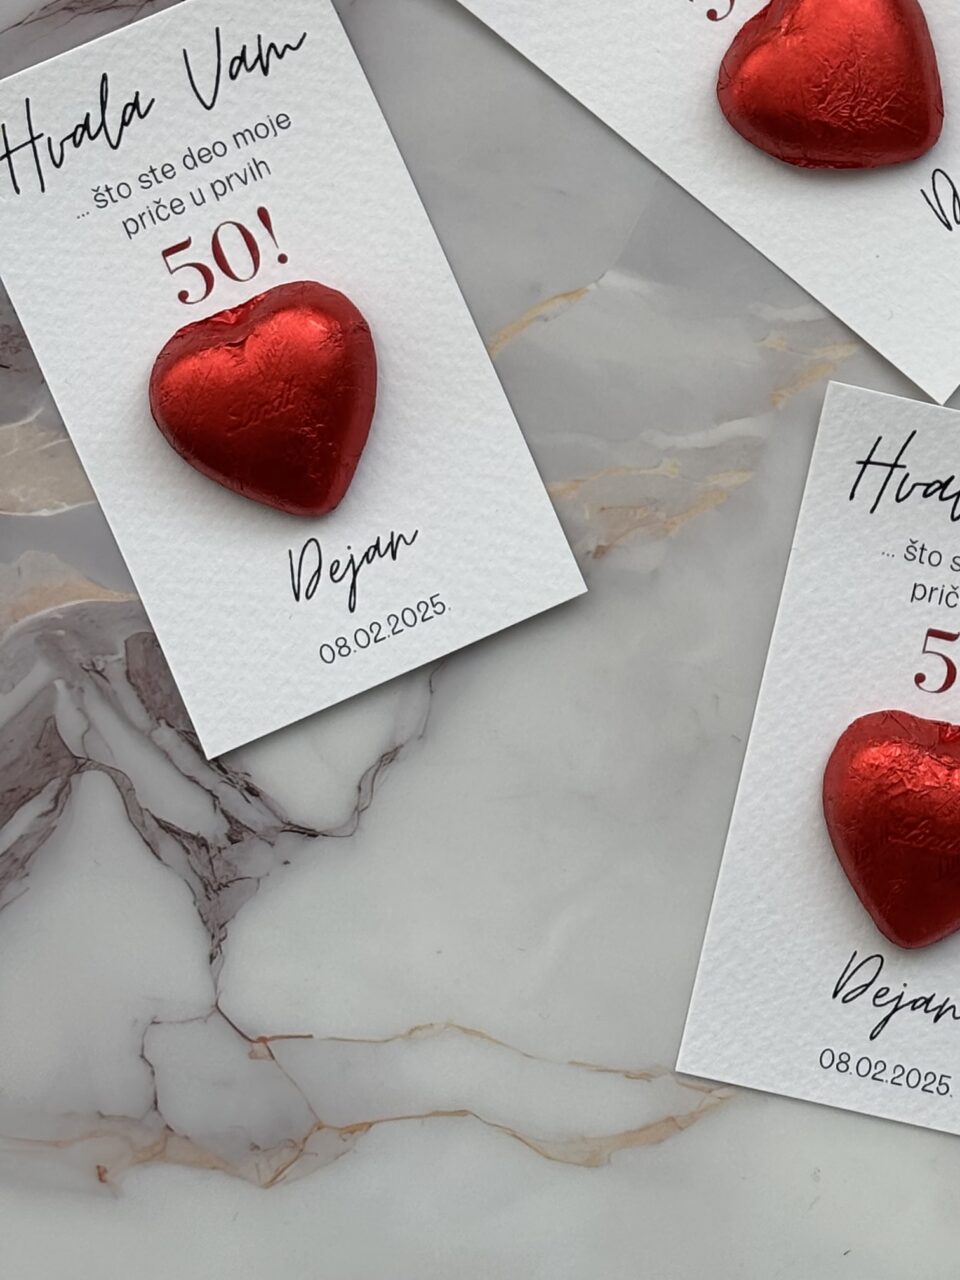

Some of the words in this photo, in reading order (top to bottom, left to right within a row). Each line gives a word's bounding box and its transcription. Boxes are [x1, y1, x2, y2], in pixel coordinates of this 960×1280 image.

[0, 72, 155, 195] Hvala
[183, 27, 307, 111] Vam
[91, 182, 132, 209] što
[138, 163, 176, 190] ste
[182, 141, 227, 170] deo
[232, 113, 291, 149] moje
[122, 197, 186, 240] priče
[189, 187, 206, 207] u
[209, 157, 271, 202] prvih
[161, 206, 288, 305] 50!
[288, 529, 419, 613] Dejan
[904, 538, 942, 567] što
[319, 593, 451, 664] 08.02.2025.
[819, 1048, 952, 1098] 08.02.2025.
